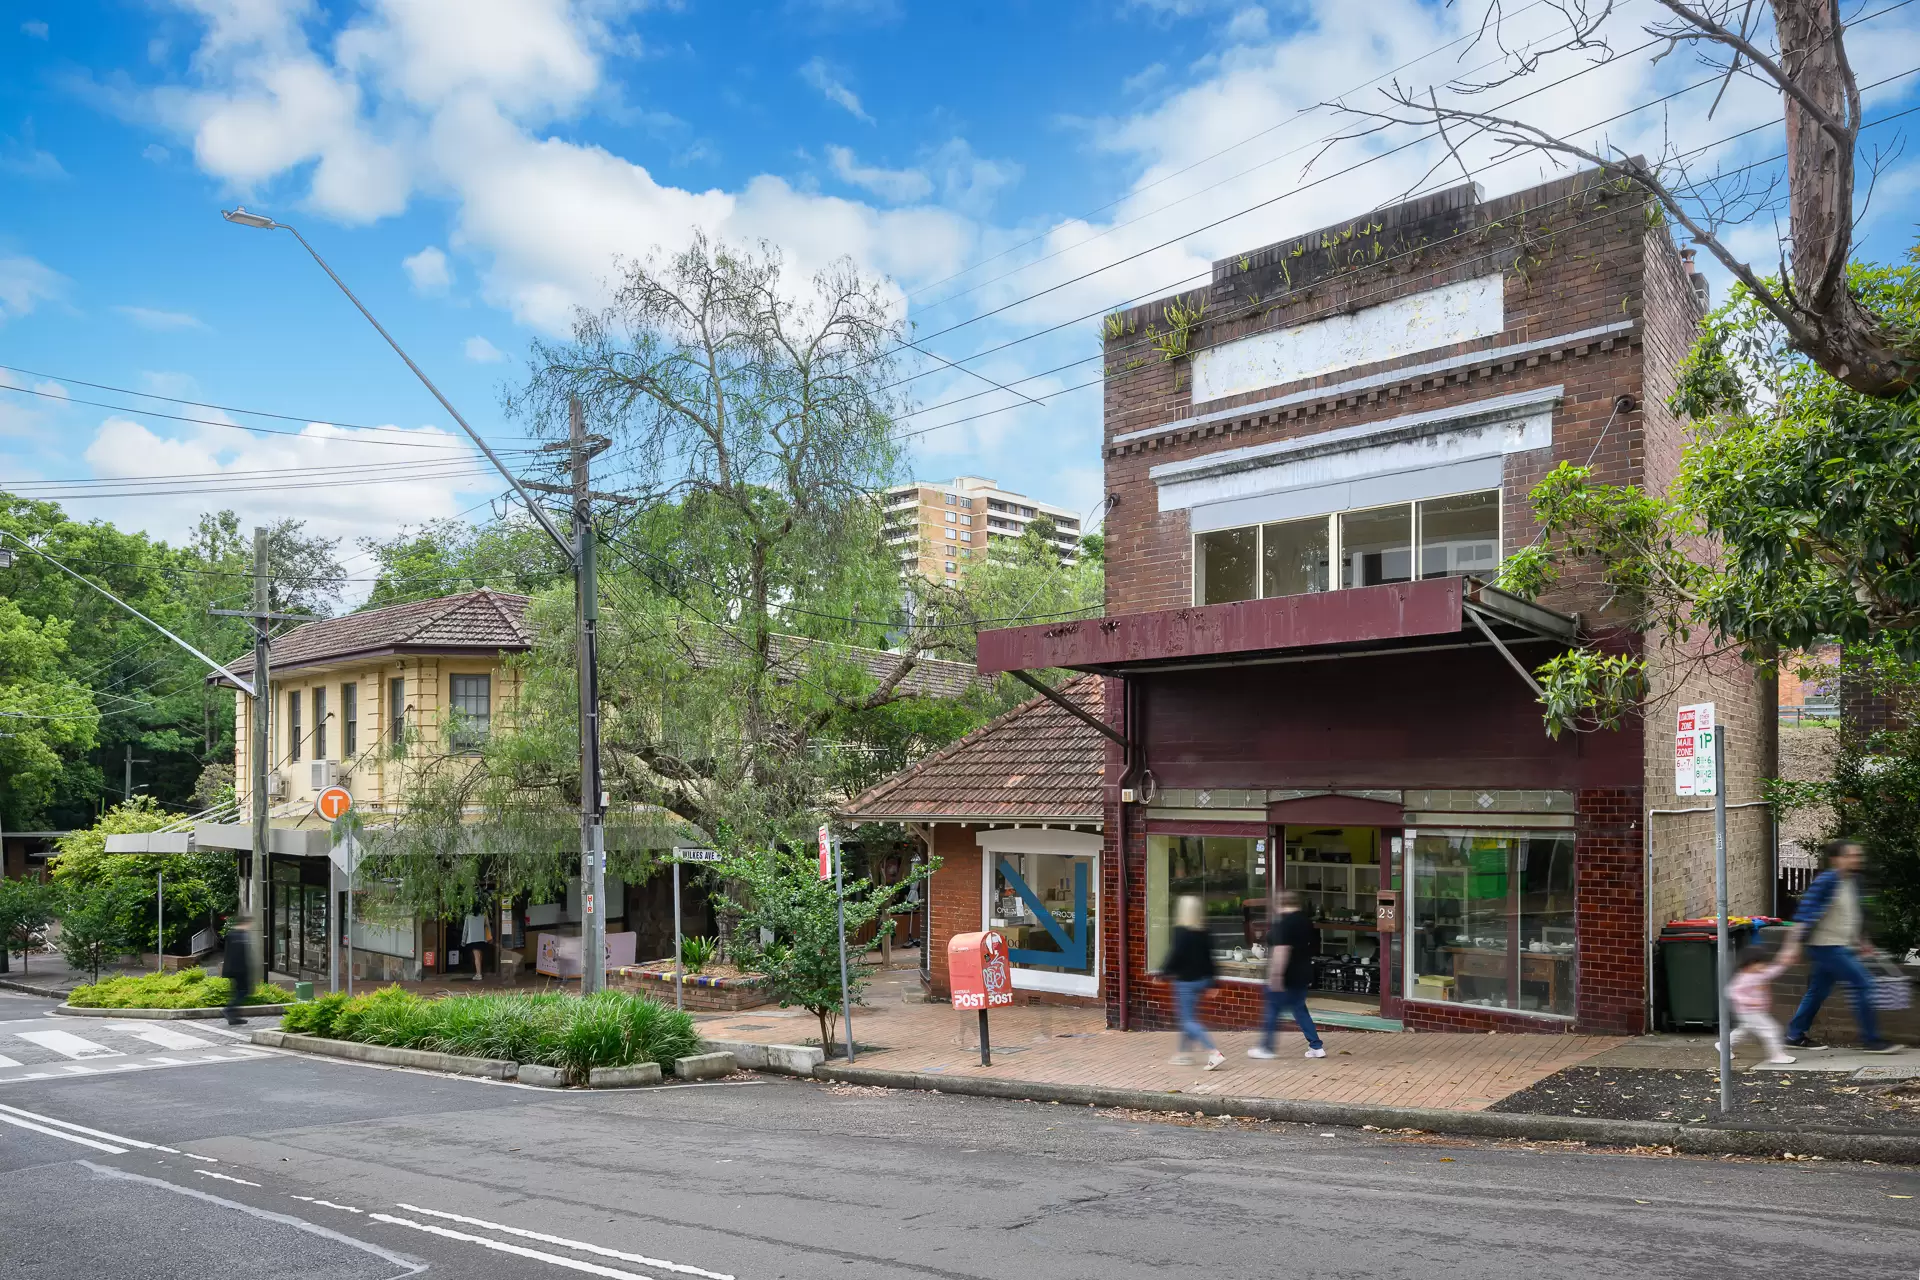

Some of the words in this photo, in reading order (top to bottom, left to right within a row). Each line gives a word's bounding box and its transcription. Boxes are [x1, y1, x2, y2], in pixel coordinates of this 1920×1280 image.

[1681, 721, 1693, 730] ZONE
[1677, 737, 1693, 746] MAIL
[1700, 732, 1712, 749] 1P
[1676, 747, 1693, 757] ZONE
[327, 795, 343, 815] T
[704, 850, 715, 860] AVE
[1378, 907, 1394, 919] 28
[954, 993, 985, 1008] POST
[988, 993, 1013, 1006] POST
